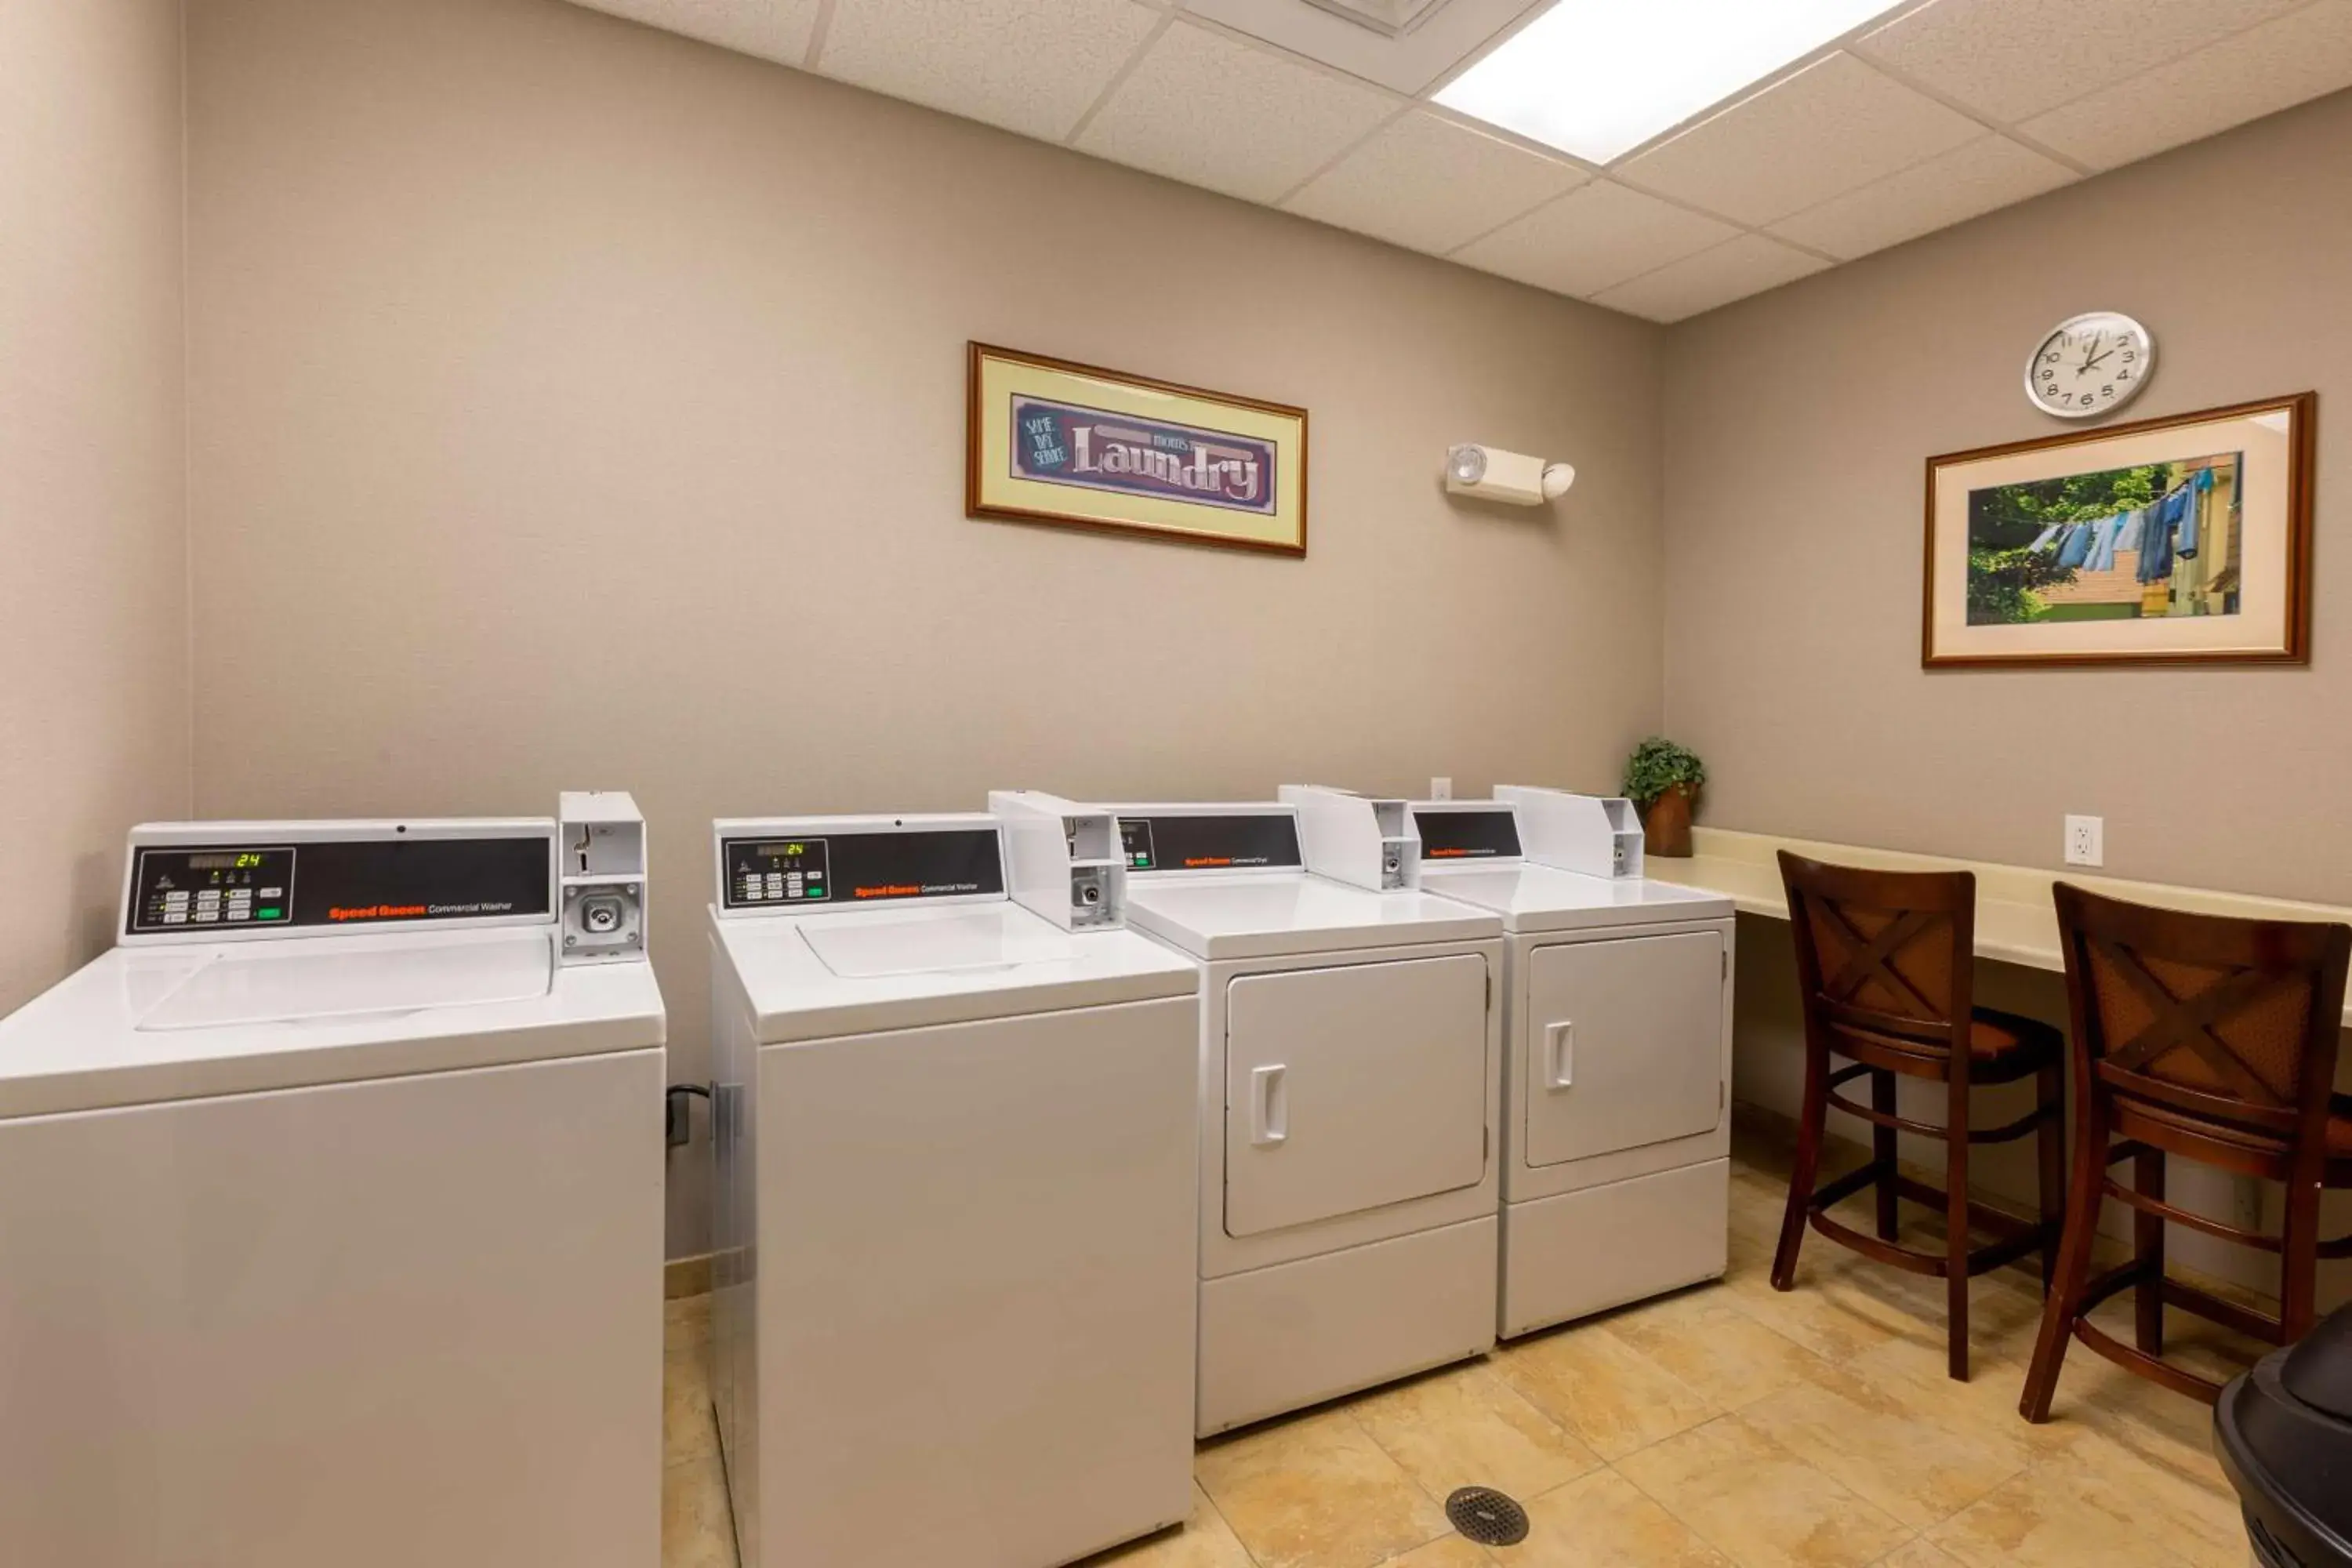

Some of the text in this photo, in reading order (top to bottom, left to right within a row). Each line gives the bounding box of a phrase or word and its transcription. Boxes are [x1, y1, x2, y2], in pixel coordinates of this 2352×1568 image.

[2061, 336, 2072, 348] 11
[2118, 336, 2129, 348] 2
[2042, 352, 2060, 364] 10
[2122, 350, 2134, 363] 3
[2042, 369, 2054, 380] 9
[2117, 369, 2128, 380] 4
[2047, 384, 2059, 396] 8
[2102, 384, 2114, 397] 5
[2062, 393, 2073, 405] 7
[2081, 394, 2094, 405] 6
[1073, 427, 1258, 500] Laundry
[787, 844, 804, 855] 24
[237, 853, 260, 868] 24
[328, 902, 512, 920] Speed Queen Commercial Washer
